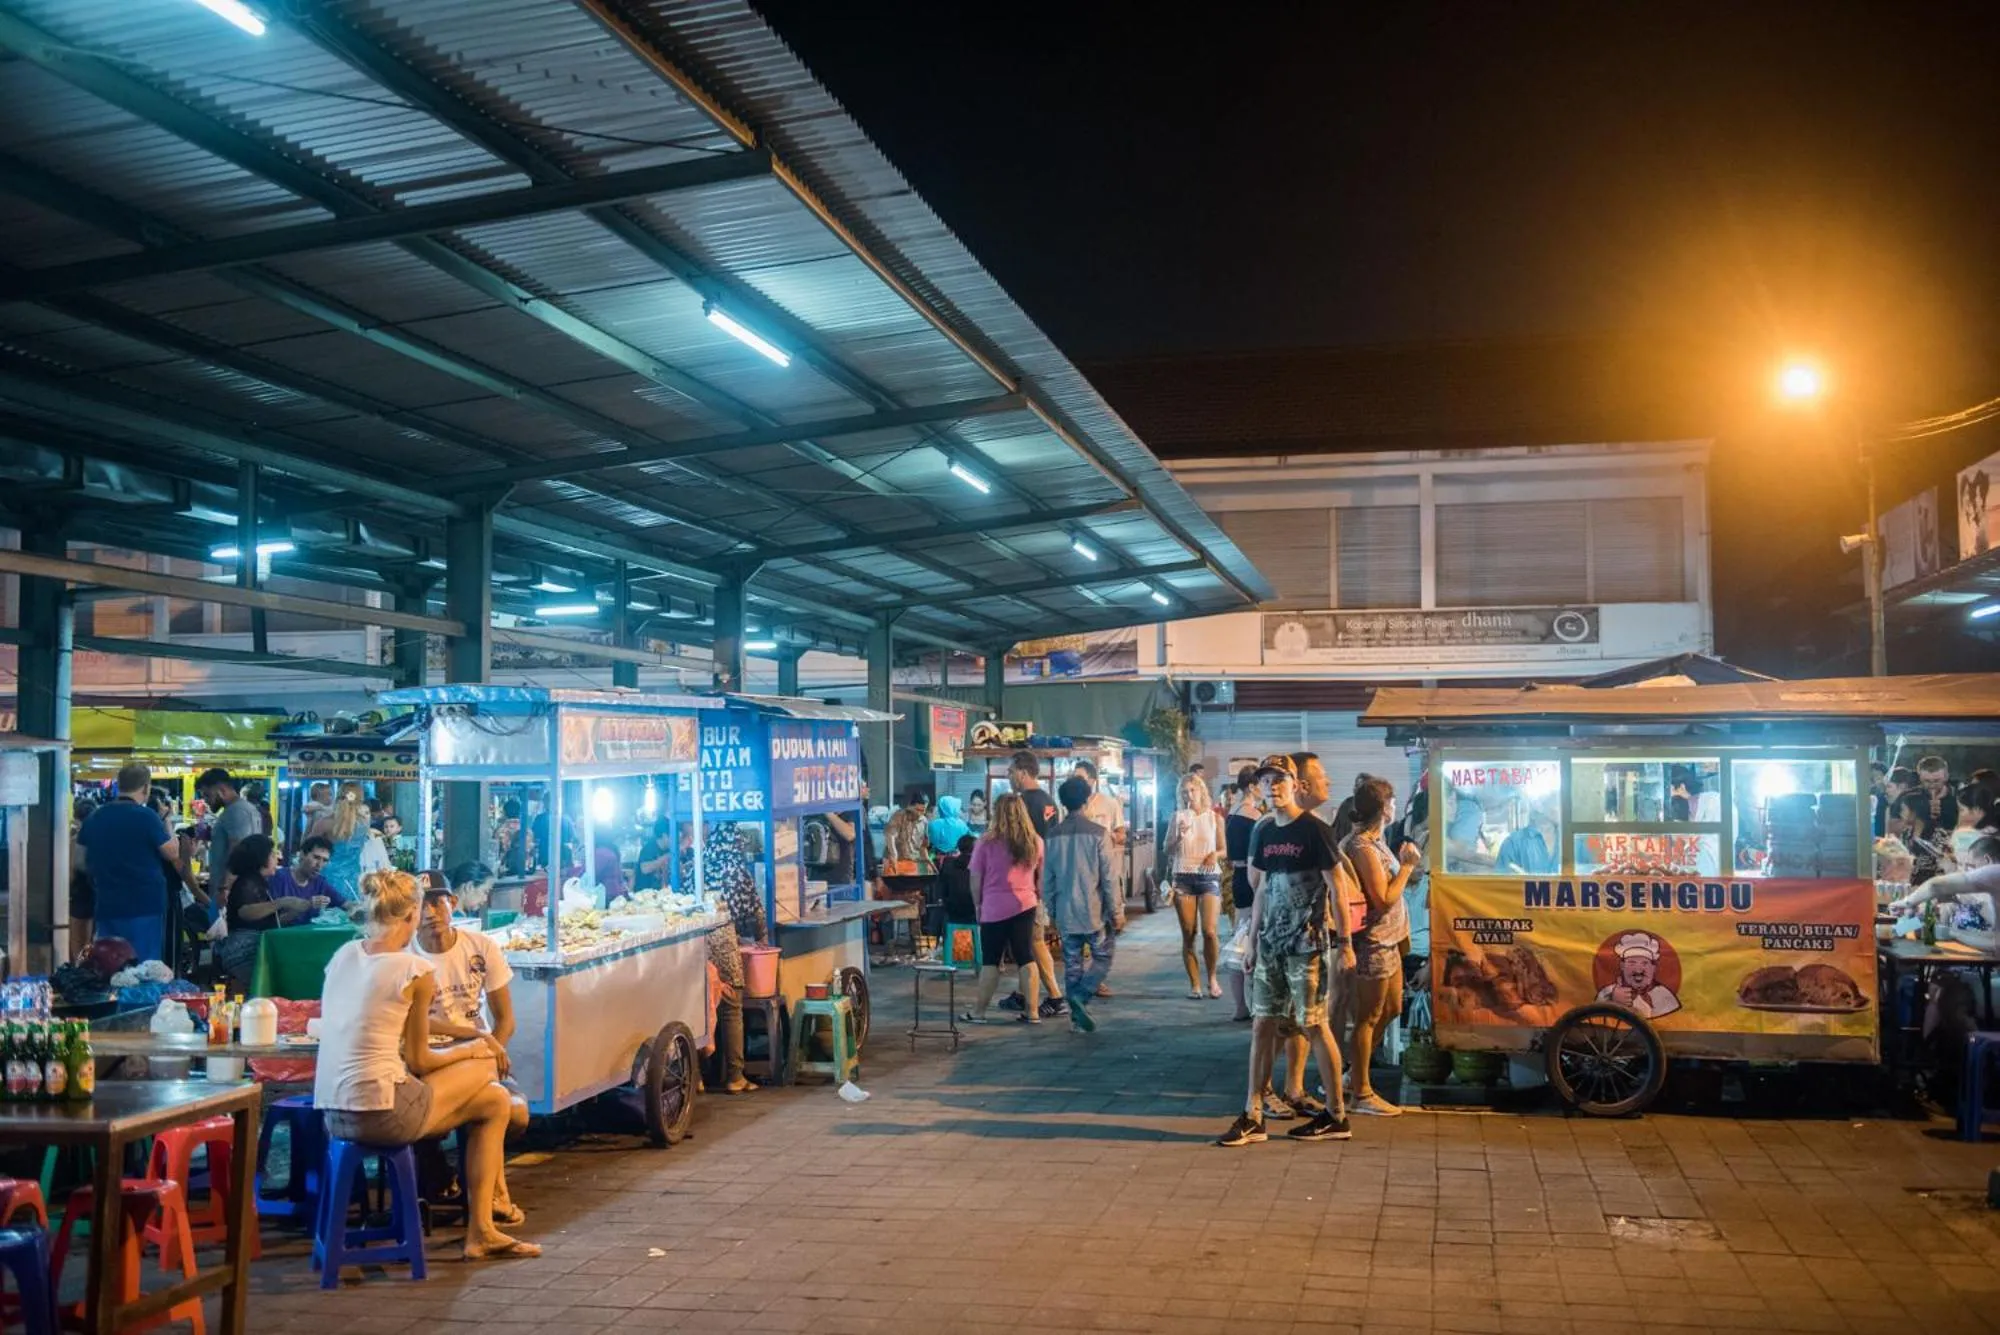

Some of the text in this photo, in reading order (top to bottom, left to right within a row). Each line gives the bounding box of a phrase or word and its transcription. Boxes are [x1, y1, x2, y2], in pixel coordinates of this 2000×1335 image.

[1461, 611, 1512, 628] dhana
[298, 750, 375, 765] GADO
[701, 746, 752, 769] AYAM
[702, 790, 765, 812] CEKER
[1523, 879, 1754, 912] MARSENGDU
[1454, 918, 1532, 931] MARTABAK
[1738, 923, 1799, 936] TERANG
[1474, 932, 1511, 944] AYAM
[1763, 937, 1833, 950] PANCAKE
